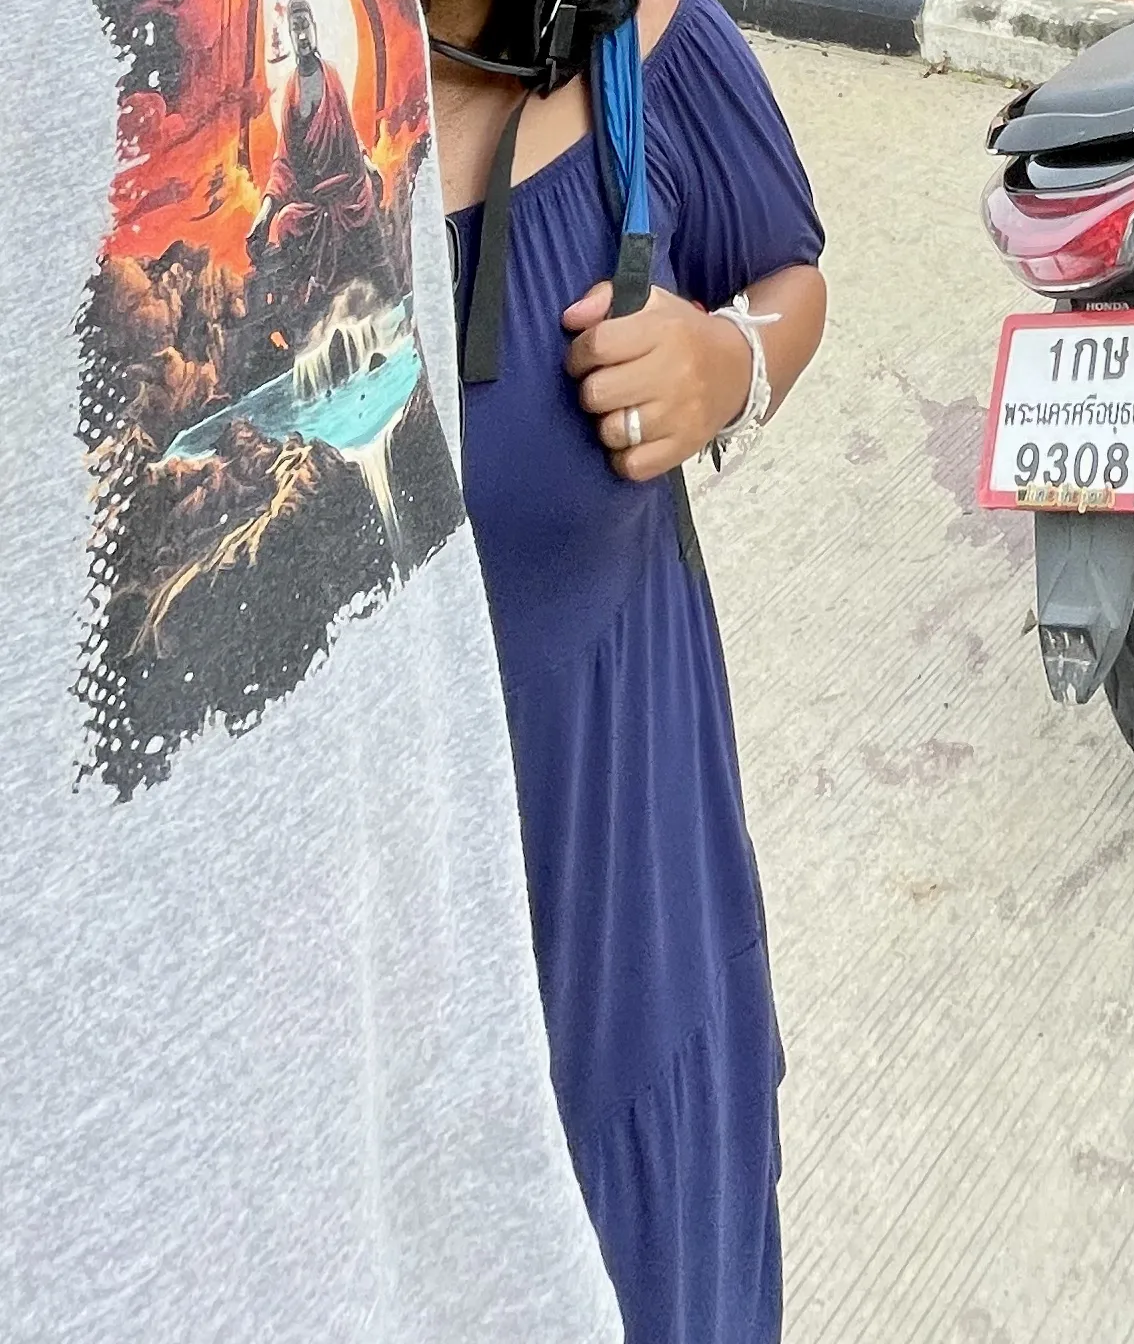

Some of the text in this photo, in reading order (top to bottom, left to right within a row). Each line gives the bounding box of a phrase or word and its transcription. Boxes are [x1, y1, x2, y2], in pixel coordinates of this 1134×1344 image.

[1086, 302, 1129, 311] HONDA
[1050, 337, 1130, 382] 1กษ
[1014, 442, 1130, 489] 9308
